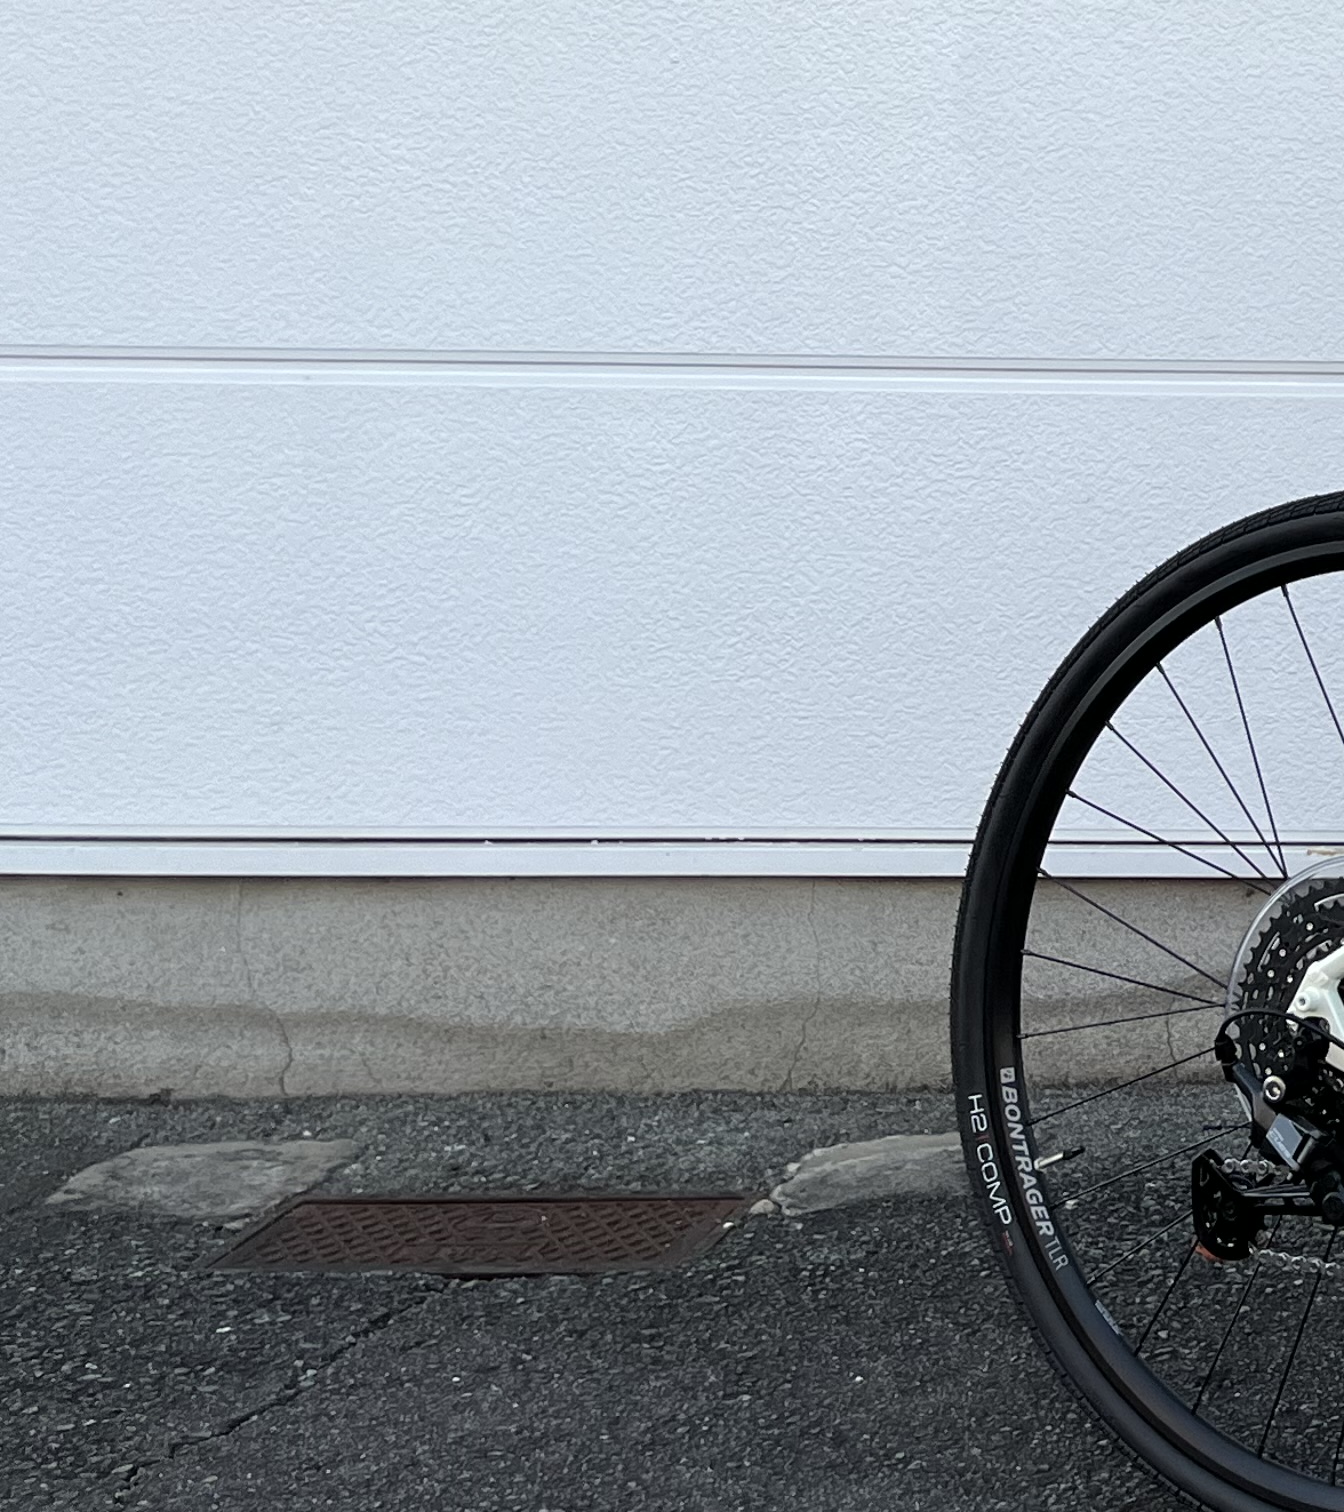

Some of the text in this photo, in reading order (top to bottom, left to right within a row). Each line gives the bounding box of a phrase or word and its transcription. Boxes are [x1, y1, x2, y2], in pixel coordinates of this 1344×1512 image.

[967, 1093, 1013, 1225] H2 COMP
[1001, 1086, 1070, 1271] BONTRAGER TLR
